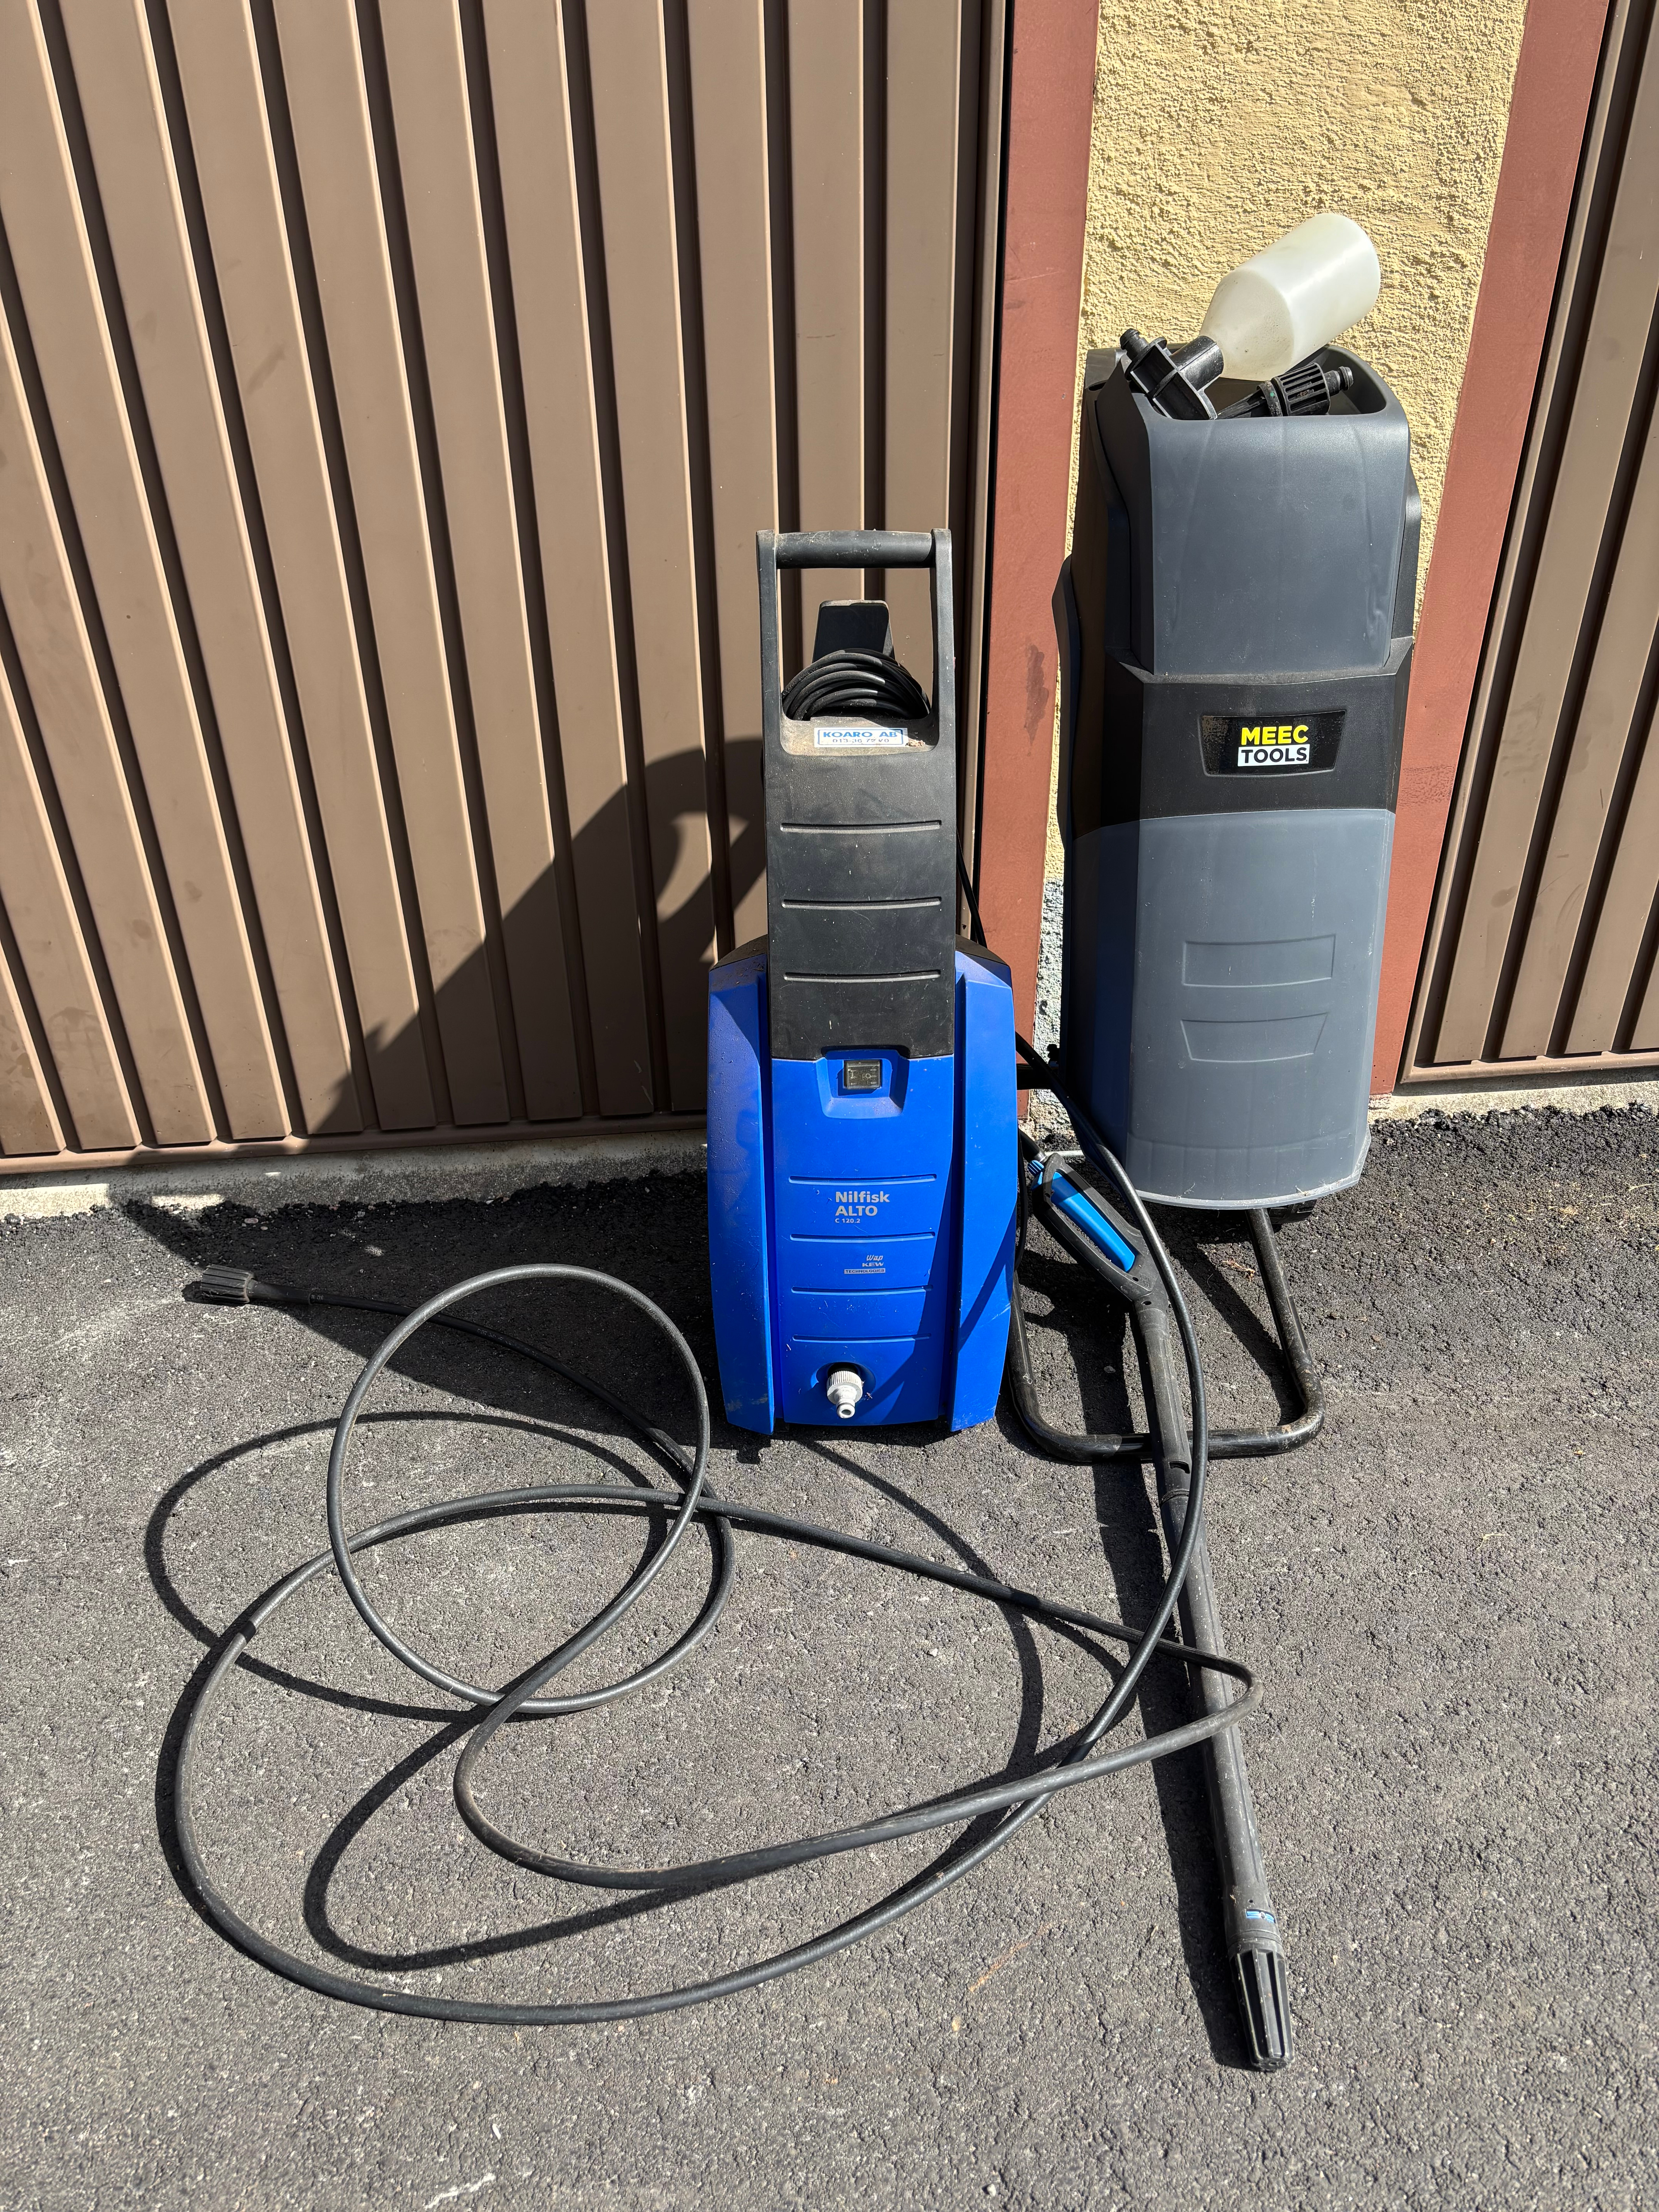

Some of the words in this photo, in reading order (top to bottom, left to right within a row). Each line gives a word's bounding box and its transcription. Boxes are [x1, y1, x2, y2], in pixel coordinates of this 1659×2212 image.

[1241, 725, 1309, 745] MEEC
[1241, 747, 1307, 763] TOOLS
[835, 1191, 890, 1202] Nilfisk
[835, 1206, 878, 1216] ALTO
